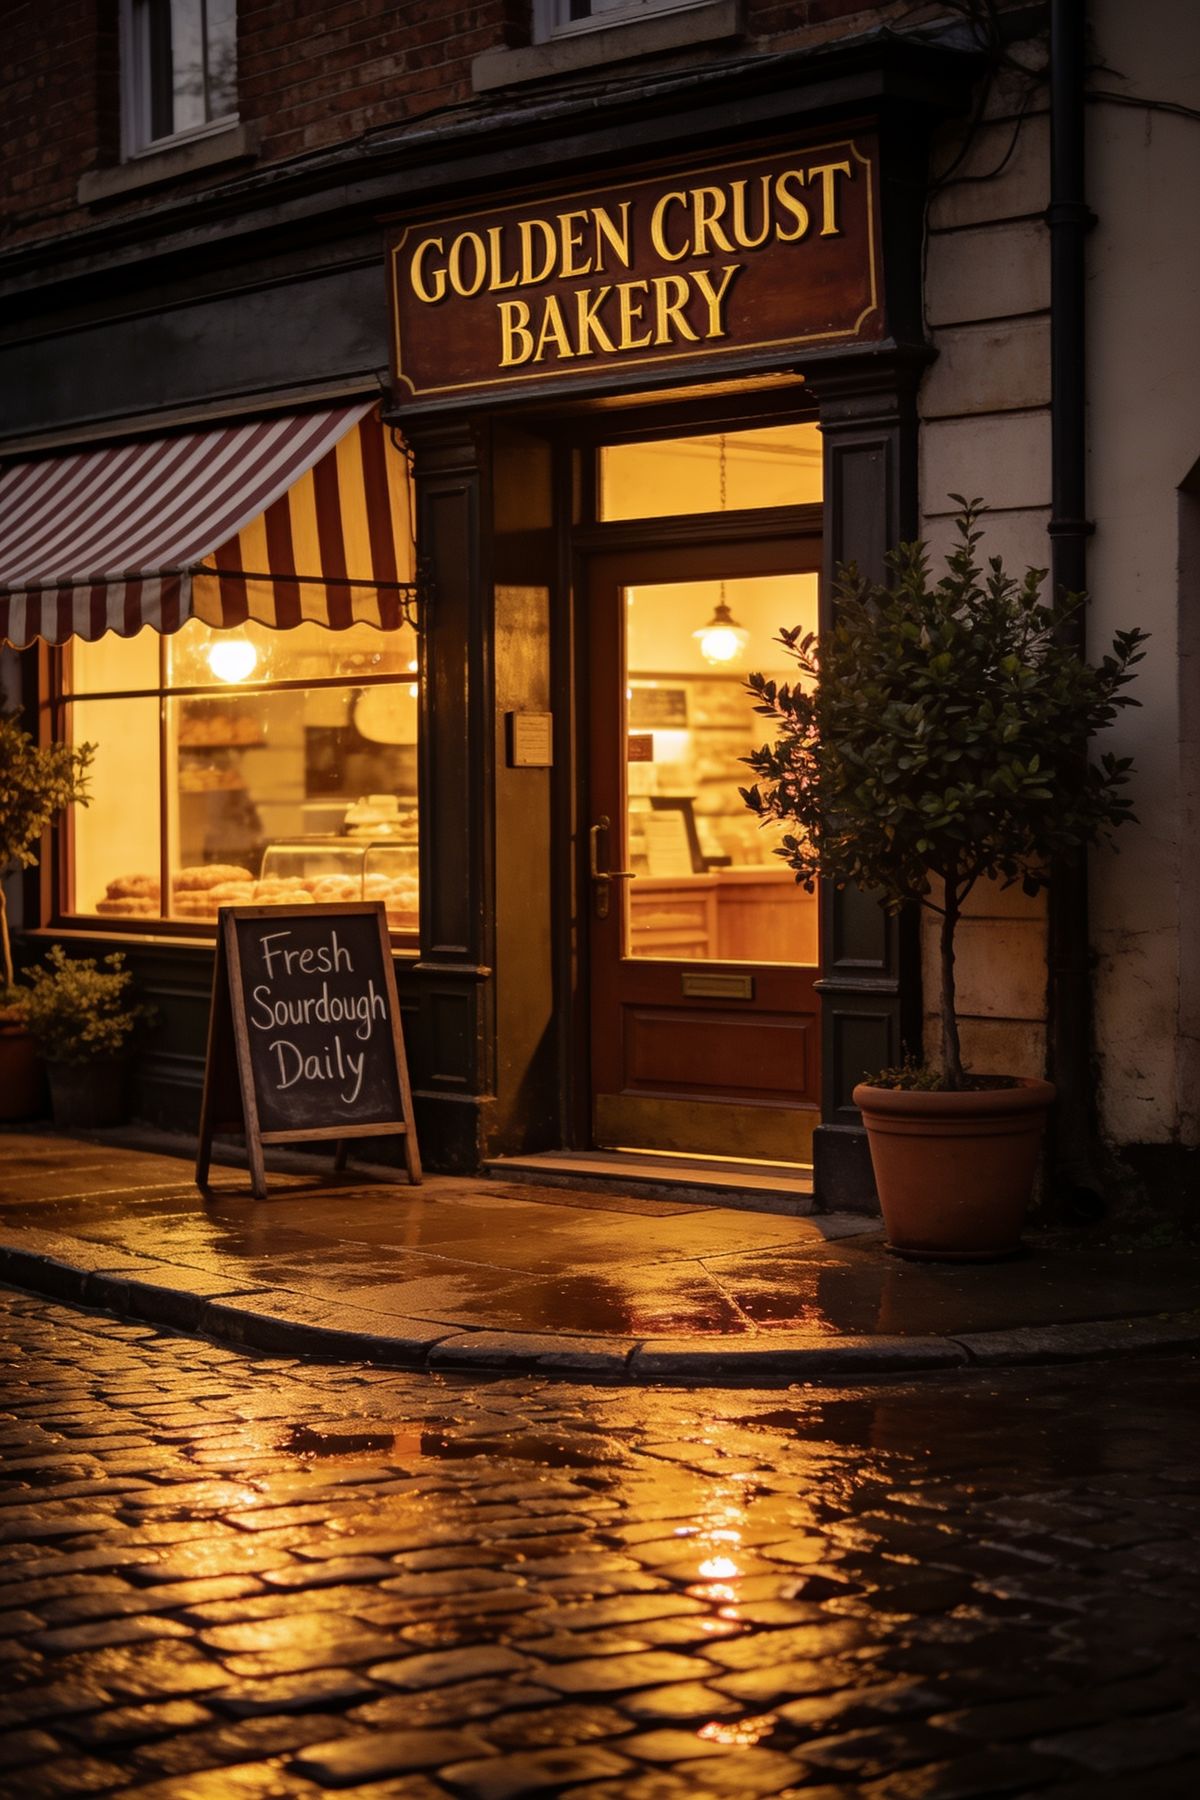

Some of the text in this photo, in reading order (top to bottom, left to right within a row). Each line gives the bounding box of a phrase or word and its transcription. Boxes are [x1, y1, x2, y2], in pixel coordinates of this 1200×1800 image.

[411, 161, 851, 303] GOLDEN CRUST
[497, 265, 740, 367] BAKERY
[259, 931, 354, 979] Fresh
[251, 979, 386, 1040] Sourdough
[269, 1036, 364, 1103] Daily
